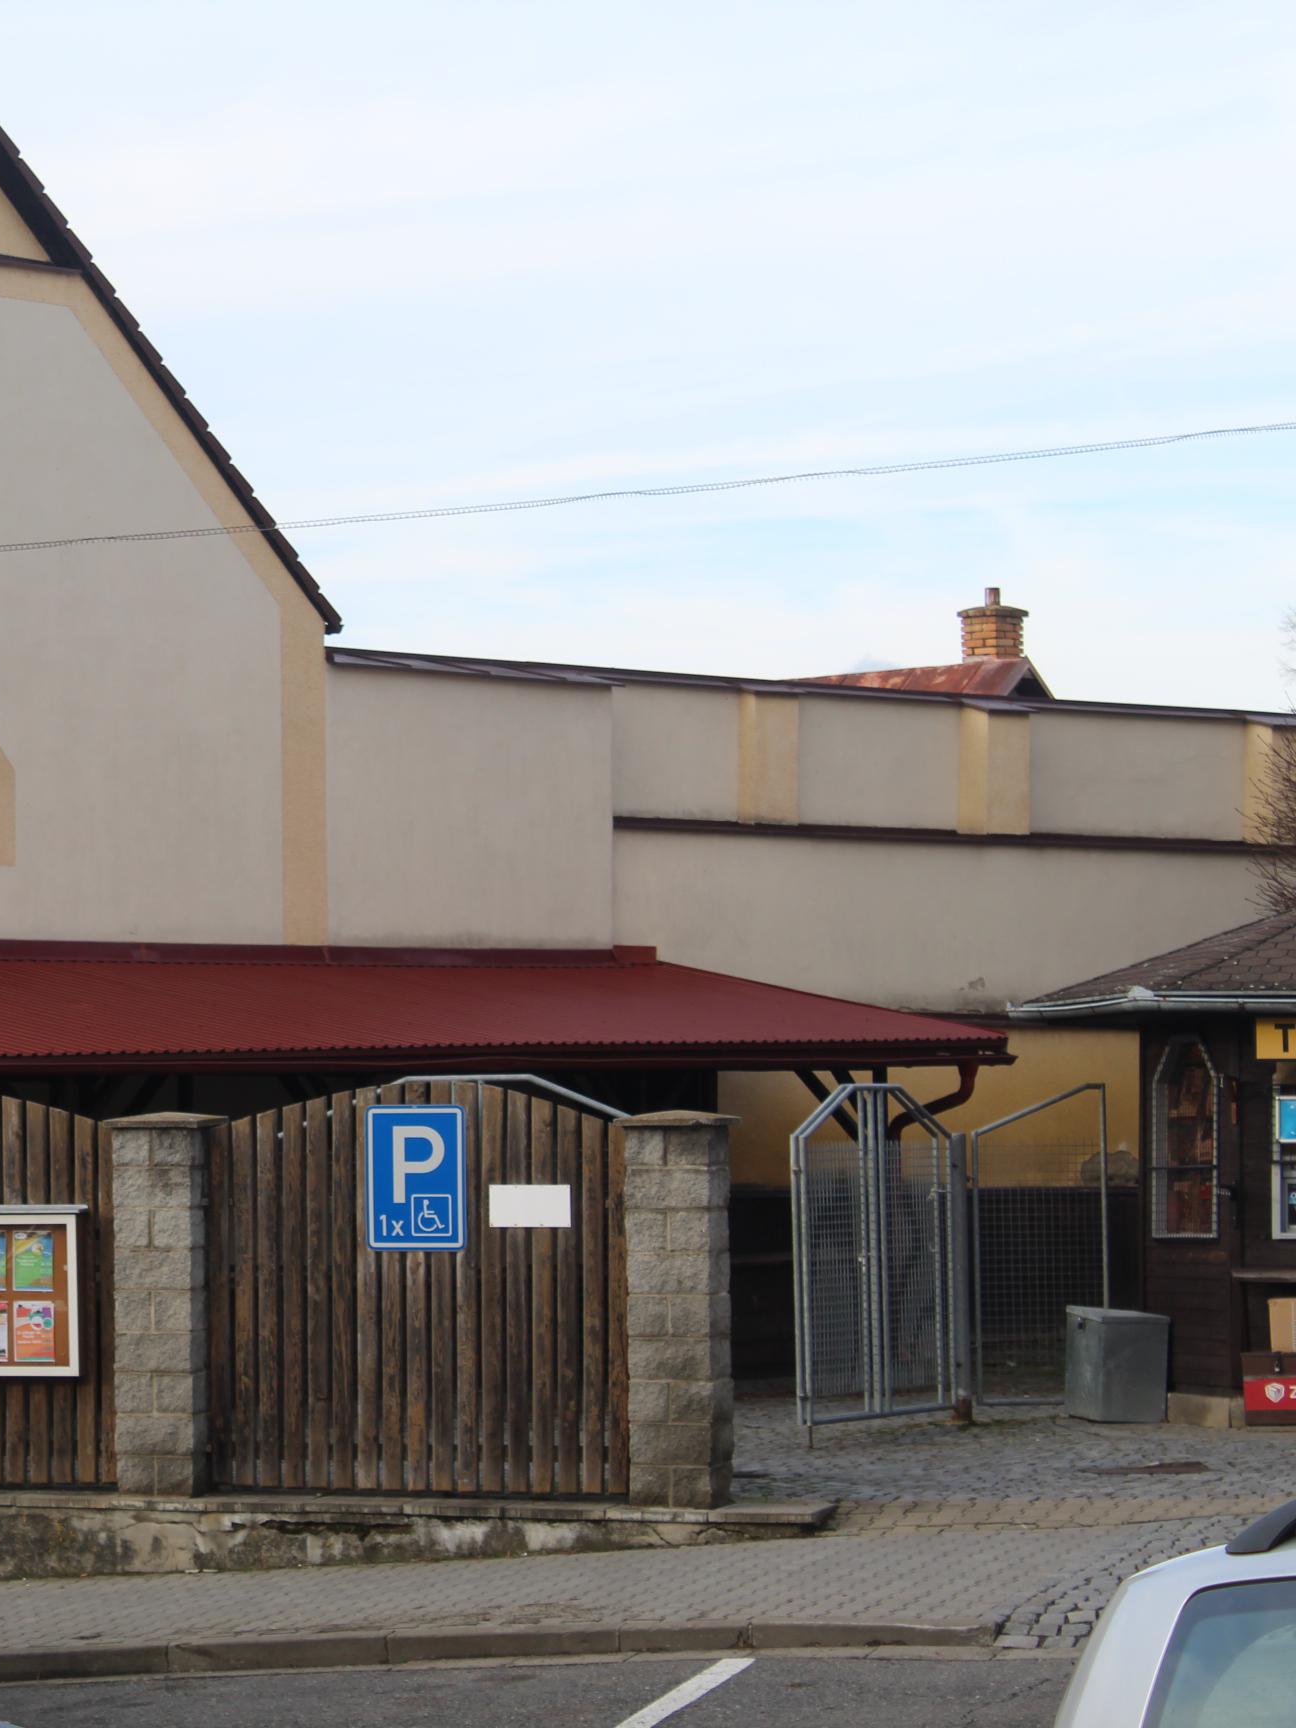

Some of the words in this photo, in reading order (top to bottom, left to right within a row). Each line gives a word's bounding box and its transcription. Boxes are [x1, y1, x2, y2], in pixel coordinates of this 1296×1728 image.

[1274, 1023, 1296, 1053] T
[391, 1125, 446, 1204] P
[379, 1214, 405, 1237] 1x
